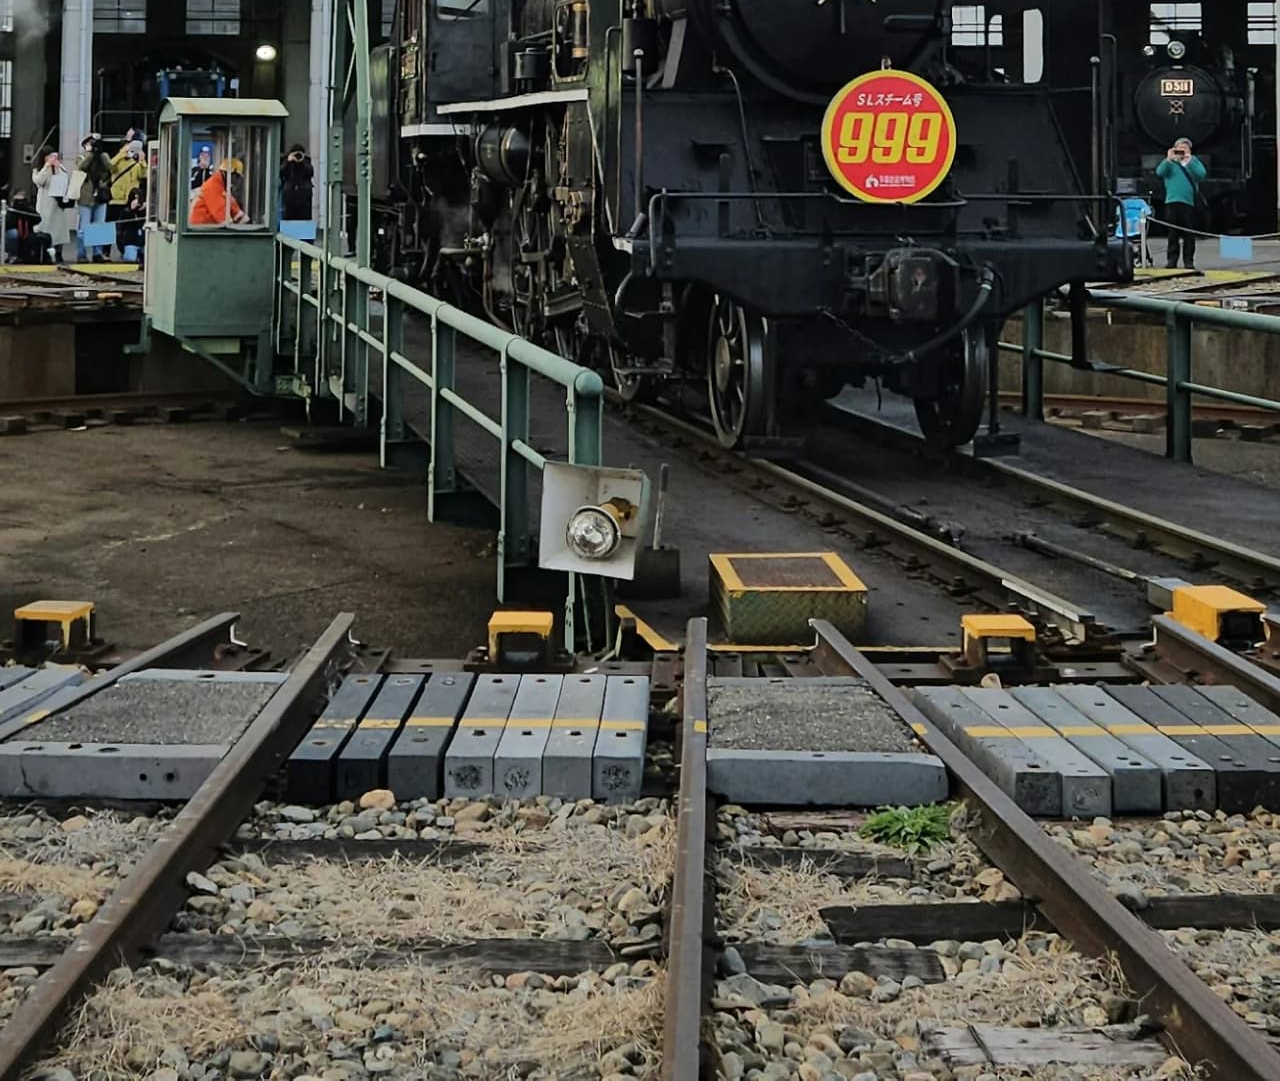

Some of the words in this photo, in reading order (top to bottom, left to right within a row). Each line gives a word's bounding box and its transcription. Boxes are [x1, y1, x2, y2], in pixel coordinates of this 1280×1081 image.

[857, 93, 922, 107] SLスチーム号
[837, 112, 943, 164] 999
